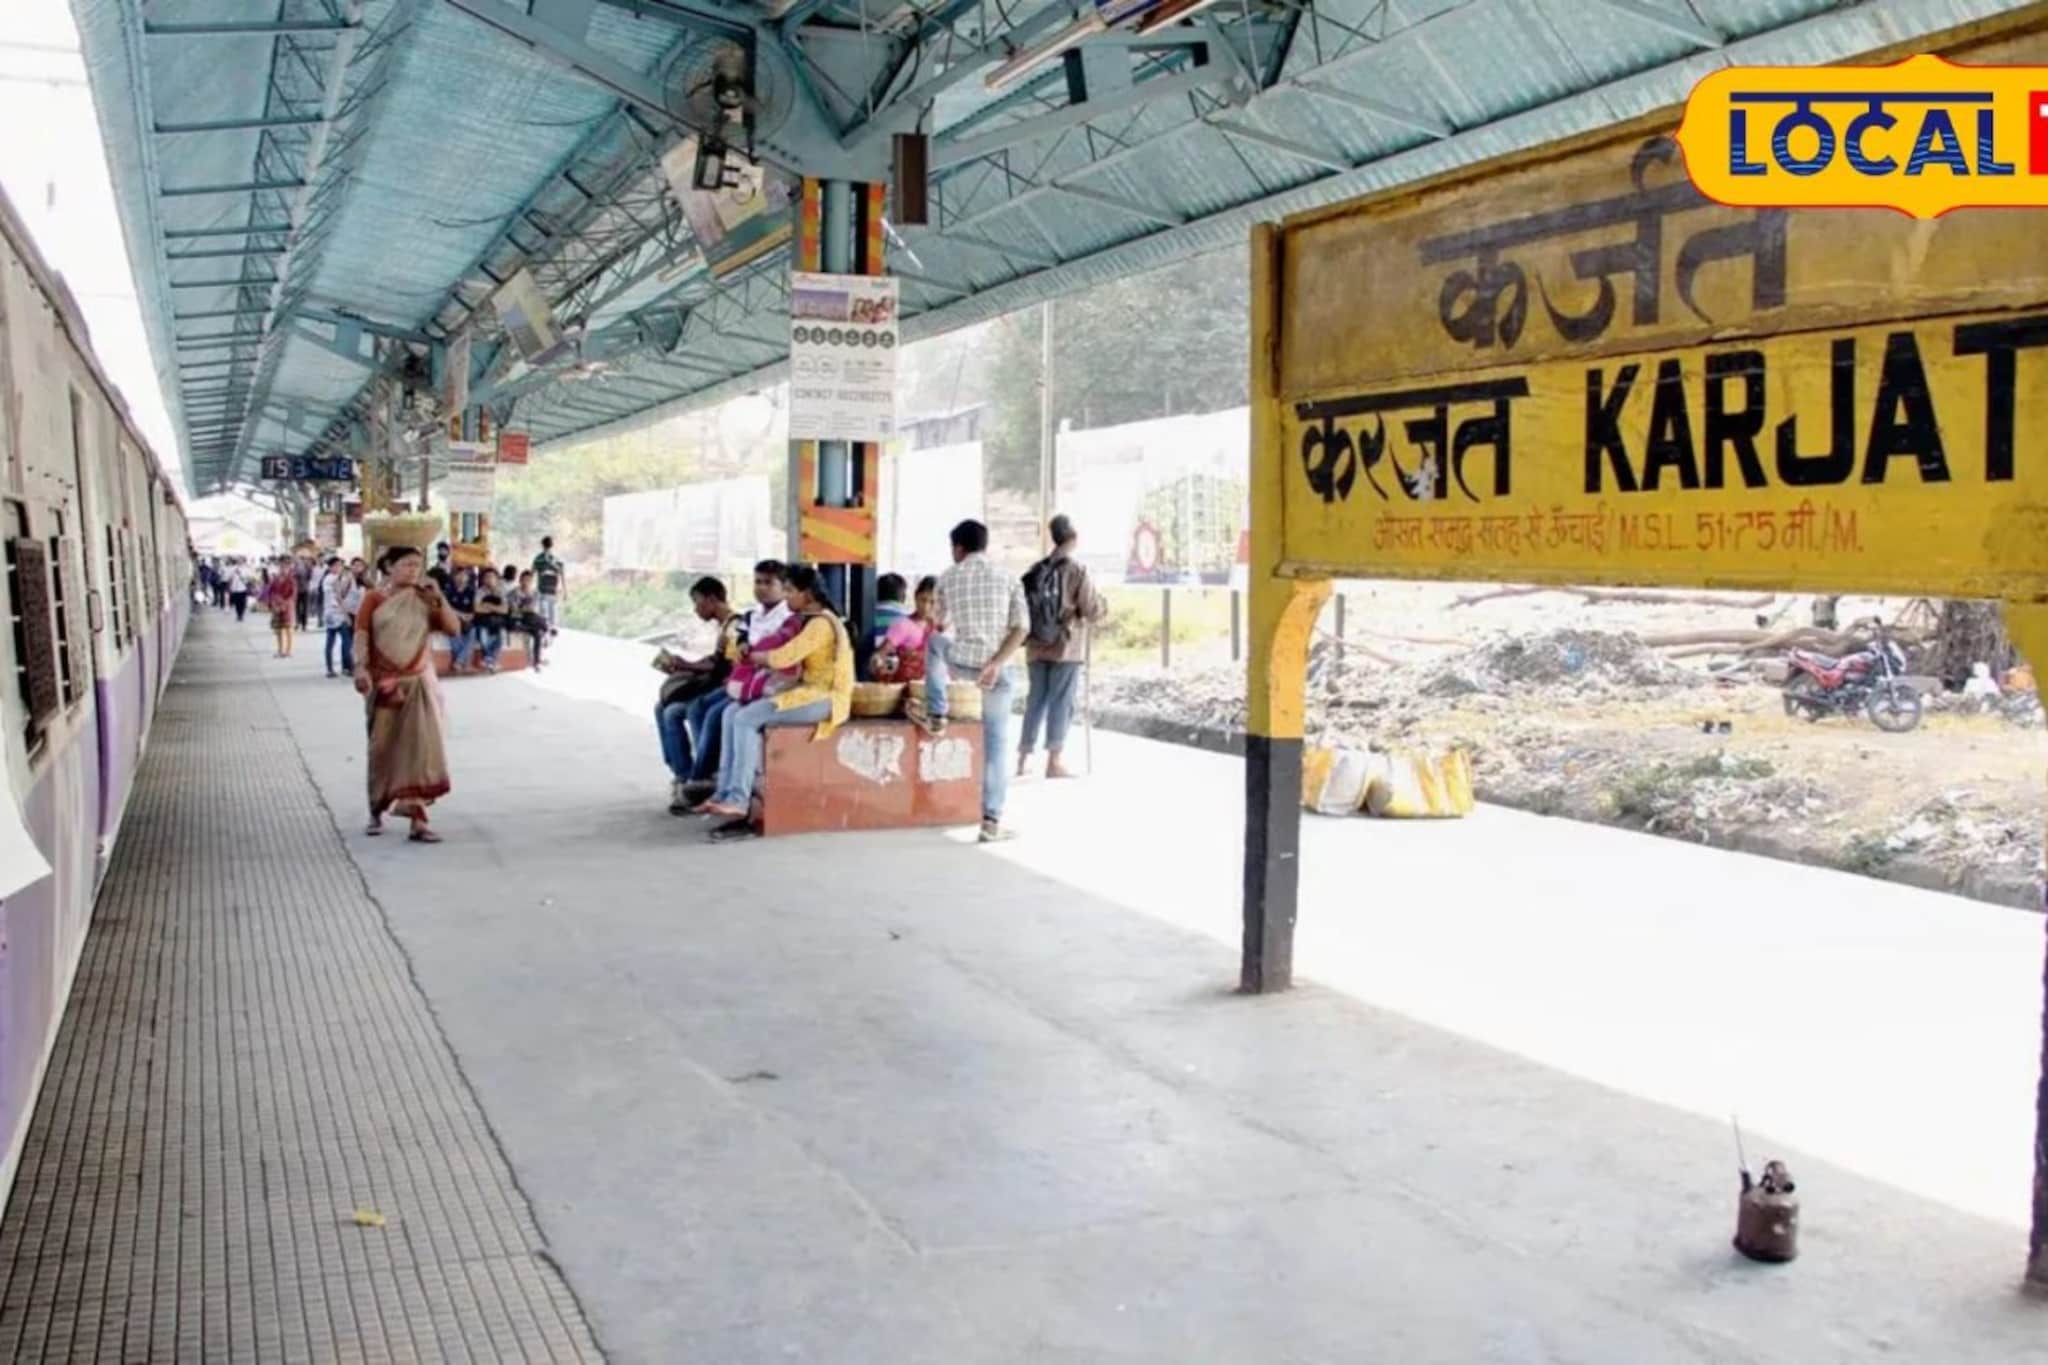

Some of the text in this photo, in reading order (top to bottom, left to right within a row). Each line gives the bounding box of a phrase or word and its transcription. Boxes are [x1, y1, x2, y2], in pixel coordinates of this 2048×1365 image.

[1417, 136, 1788, 350] कर्जत
[1294, 314, 2048, 504] करजत KARJAT
